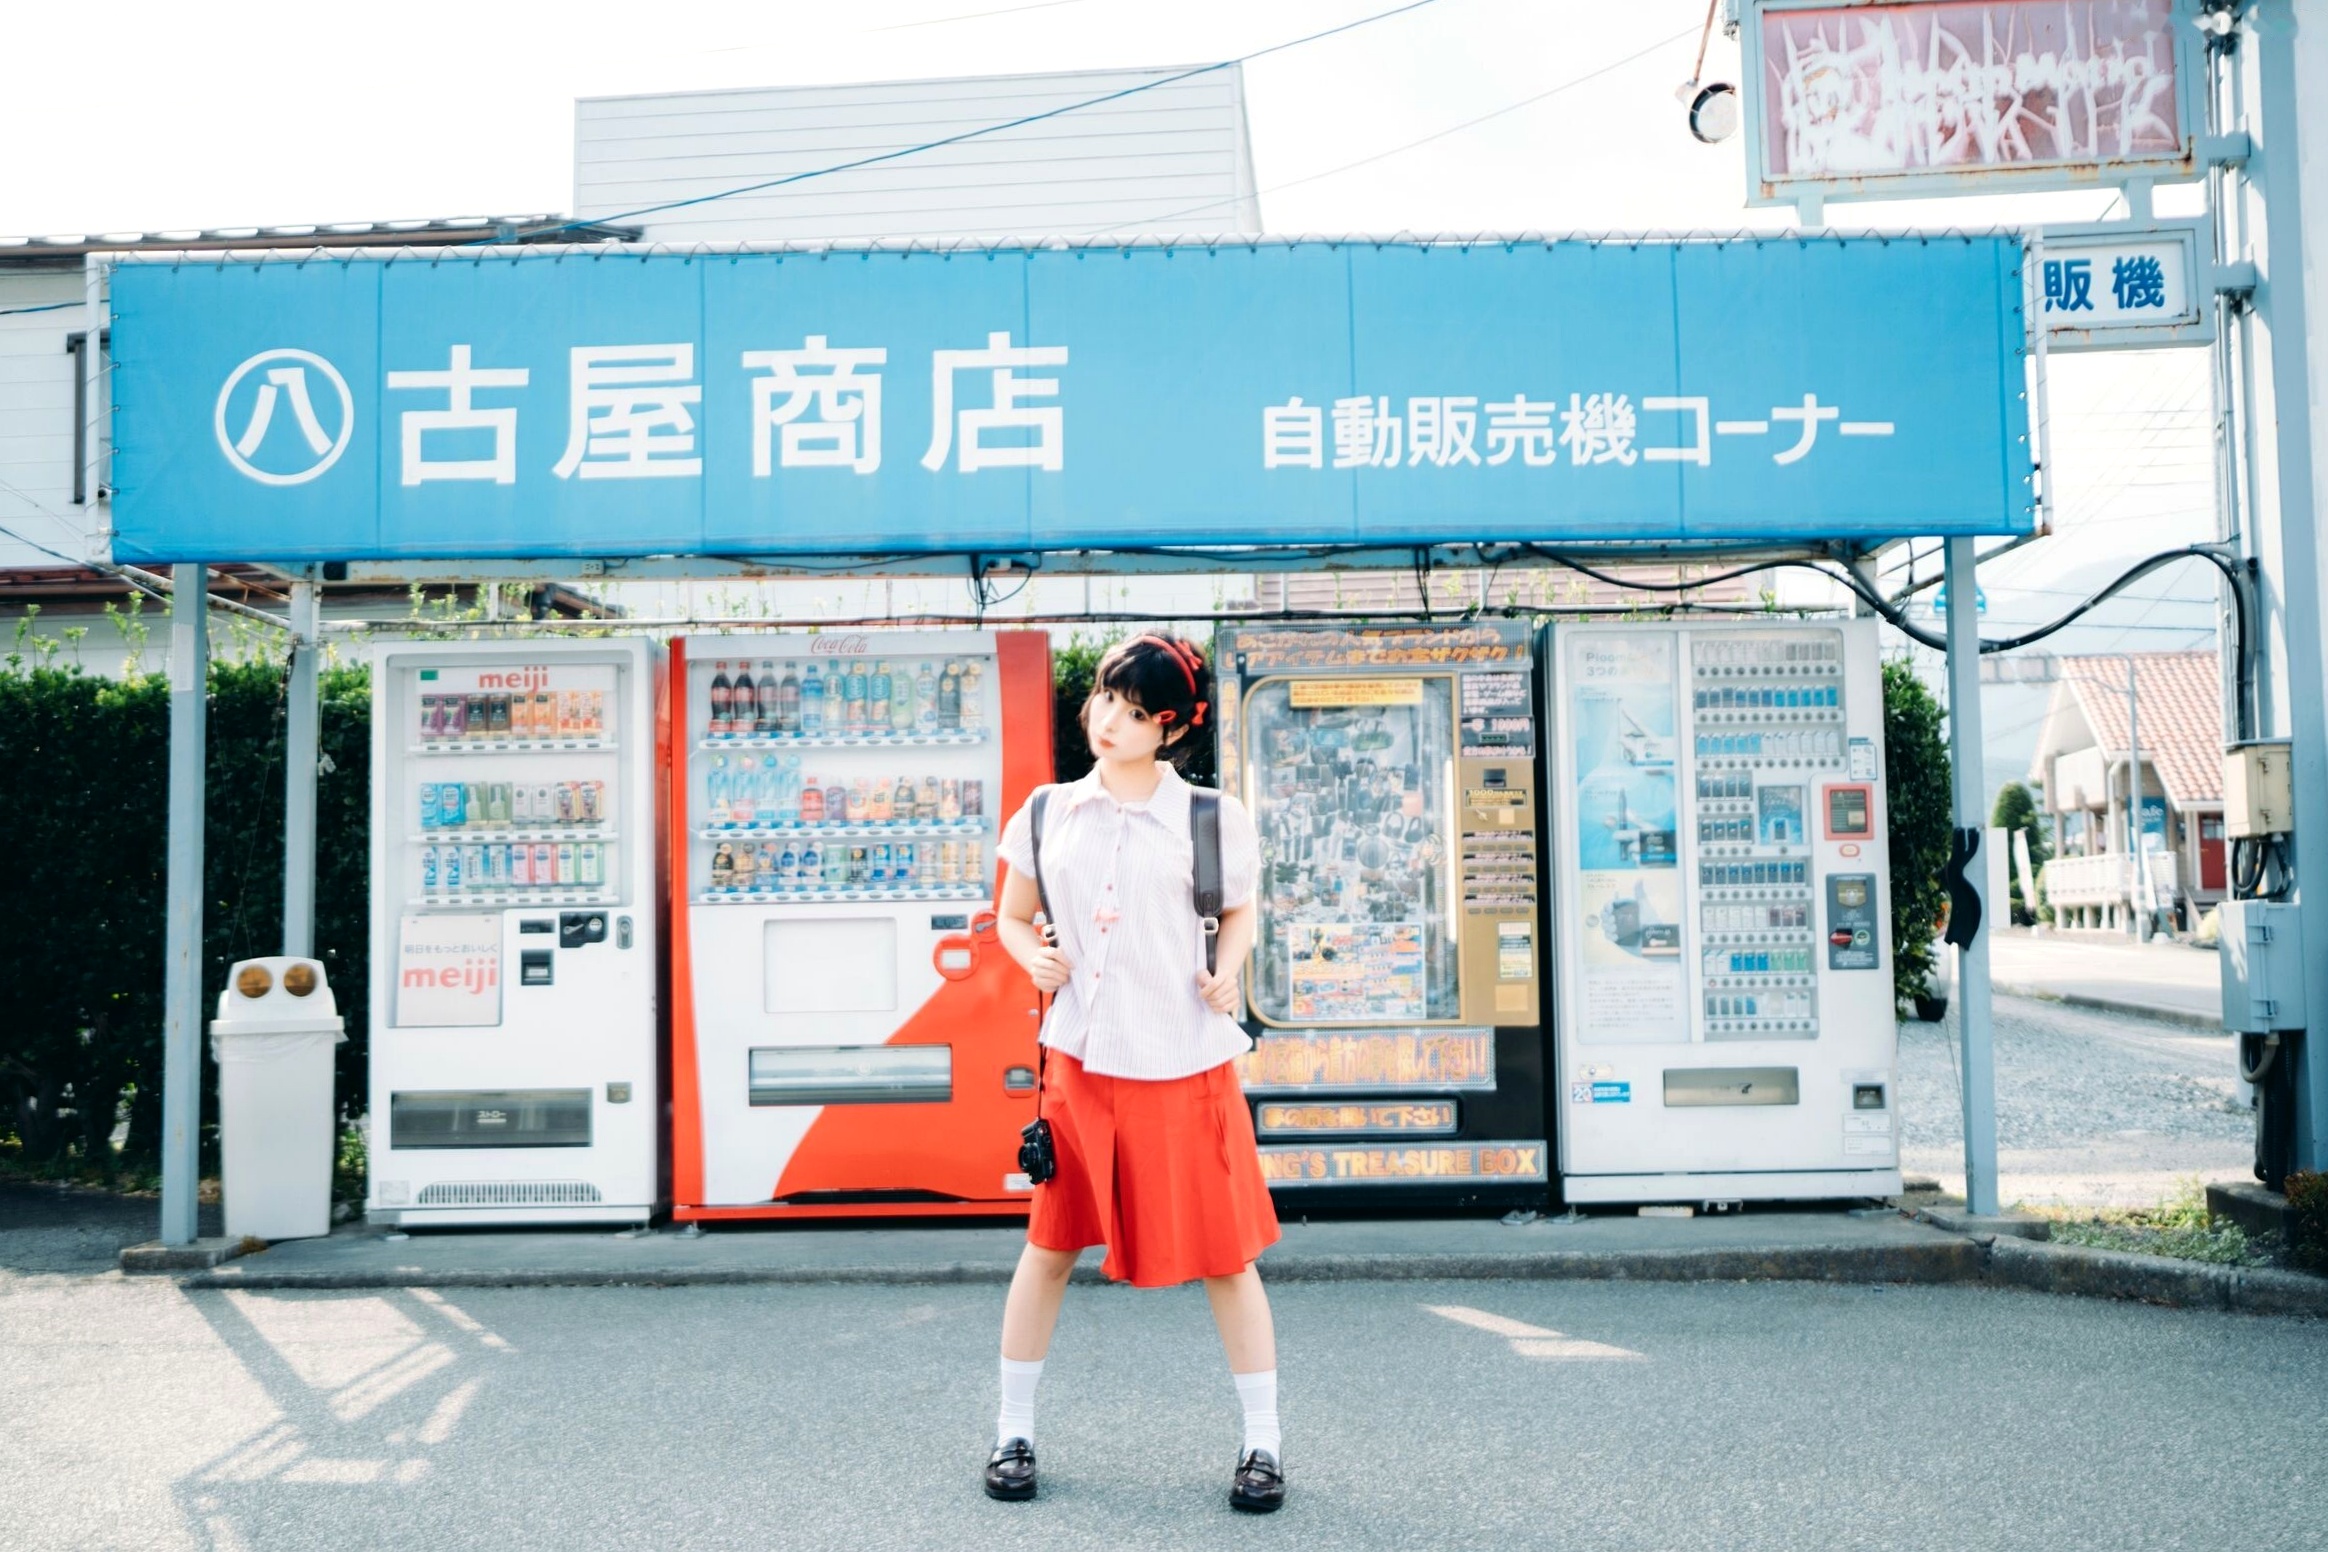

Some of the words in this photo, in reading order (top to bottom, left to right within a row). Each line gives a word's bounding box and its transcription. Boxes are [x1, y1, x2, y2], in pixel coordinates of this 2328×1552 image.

[387, 331, 1069, 486] 古屋商店
[1262, 393, 1895, 470] 自動販売機コーナー
[479, 666, 549, 692] meiji
[404, 943, 498, 954] 明日をもっとおいしく
[403, 958, 497, 995] meiji
[476, 1110, 507, 1119] ストロー
[1333, 1149, 1472, 1177] TREASURE
[1479, 1148, 1538, 1174] BOX
